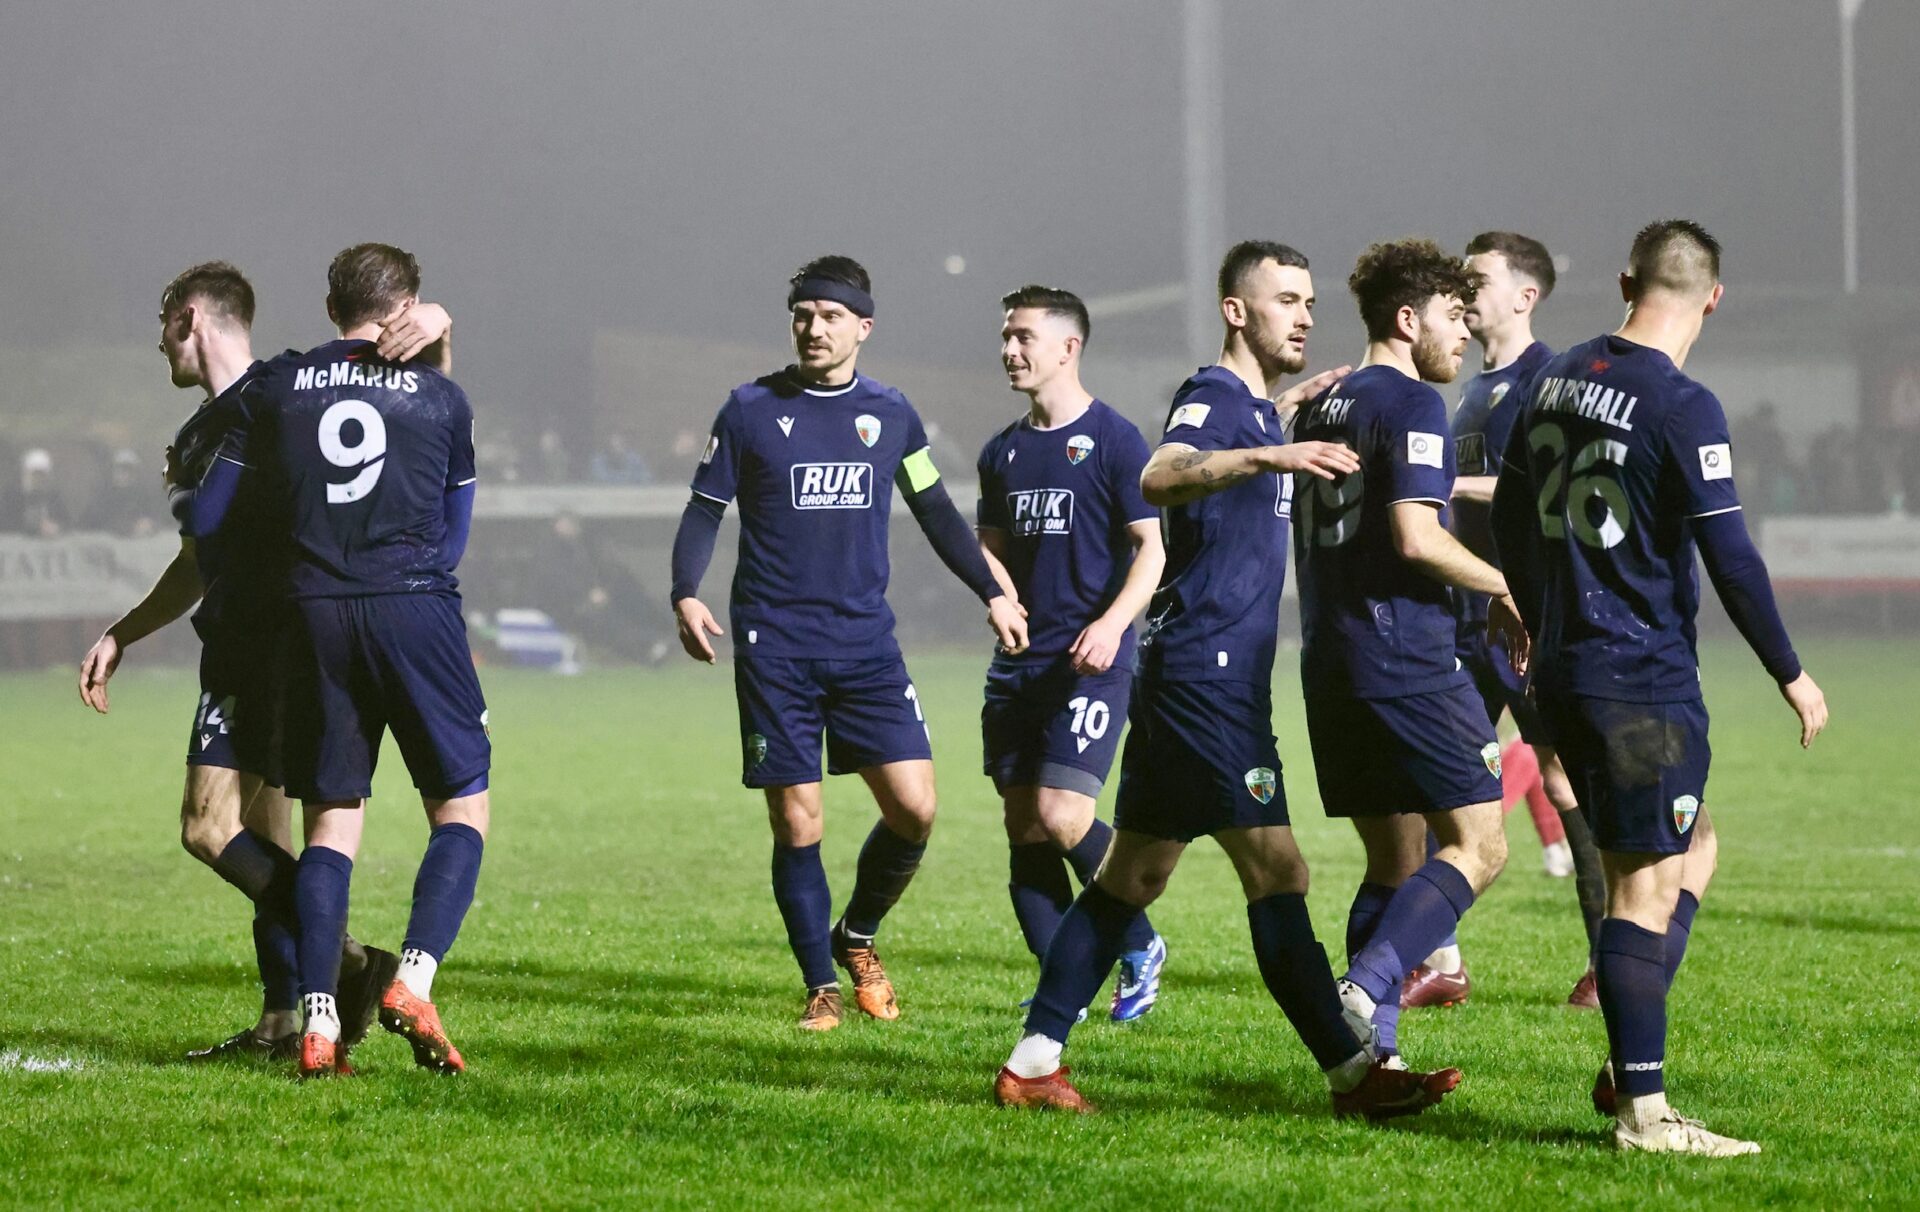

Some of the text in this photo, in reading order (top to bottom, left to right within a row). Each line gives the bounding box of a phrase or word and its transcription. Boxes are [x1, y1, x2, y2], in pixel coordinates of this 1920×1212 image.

[293, 361, 419, 394] McMANUS
[317, 399, 388, 504] 9
[801, 466, 867, 494] RUK
[1528, 421, 1631, 550] 26
[799, 493, 866, 506] GROUP.COM
[1015, 492, 1068, 520] RUK
[1068, 696, 1110, 740] 10
